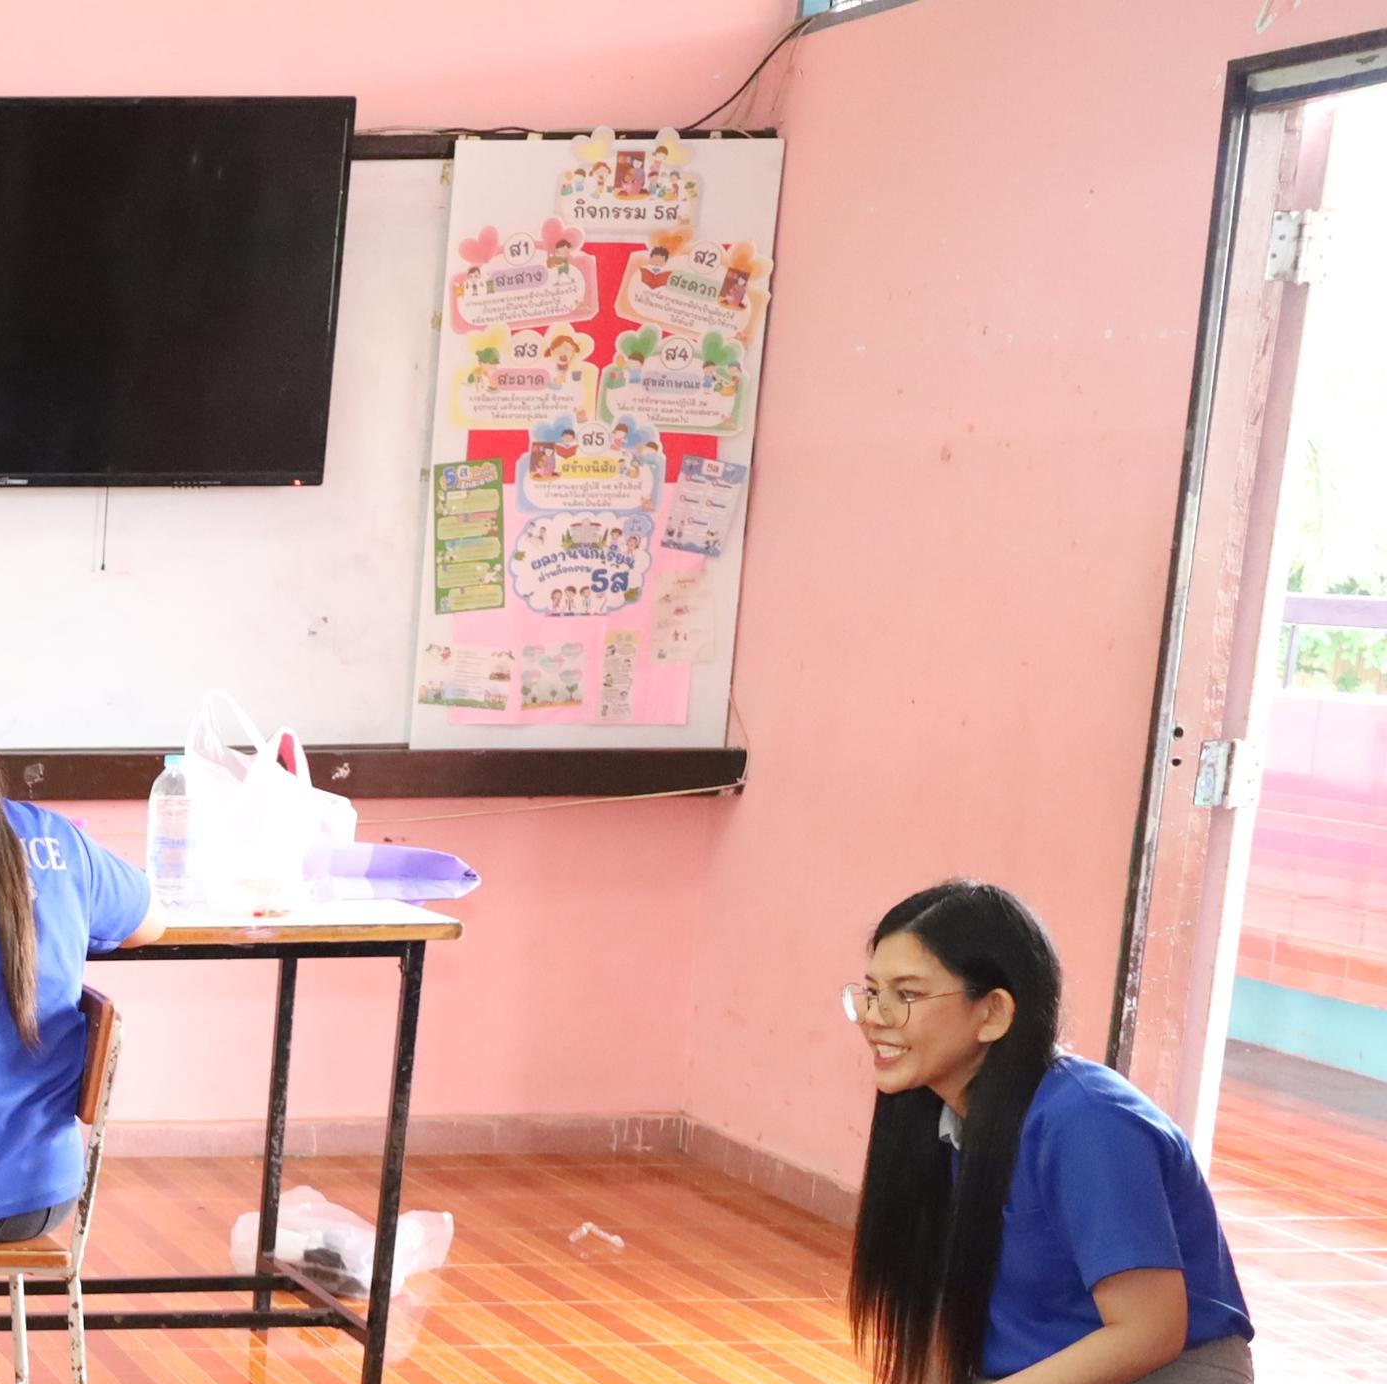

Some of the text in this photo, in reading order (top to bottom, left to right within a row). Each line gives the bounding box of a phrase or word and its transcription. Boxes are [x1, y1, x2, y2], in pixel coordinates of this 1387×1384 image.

[573, 197, 680, 221] กิจกรรม 5ส
[507, 239, 532, 258] ส1
[692, 249, 719, 269] ส2
[493, 269, 544, 289] สะสาง
[669, 274, 717, 298] สะดวก
[513, 340, 540, 360] ส3
[663, 345, 690, 362] ส4
[496, 373, 546, 387] สะอาด
[642, 375, 701, 392] สุขลักษณะ
[581, 432, 606, 447] ส5
[561, 459, 617, 474] สร้างนิสัย
[590, 568, 630, 594] 5ส
